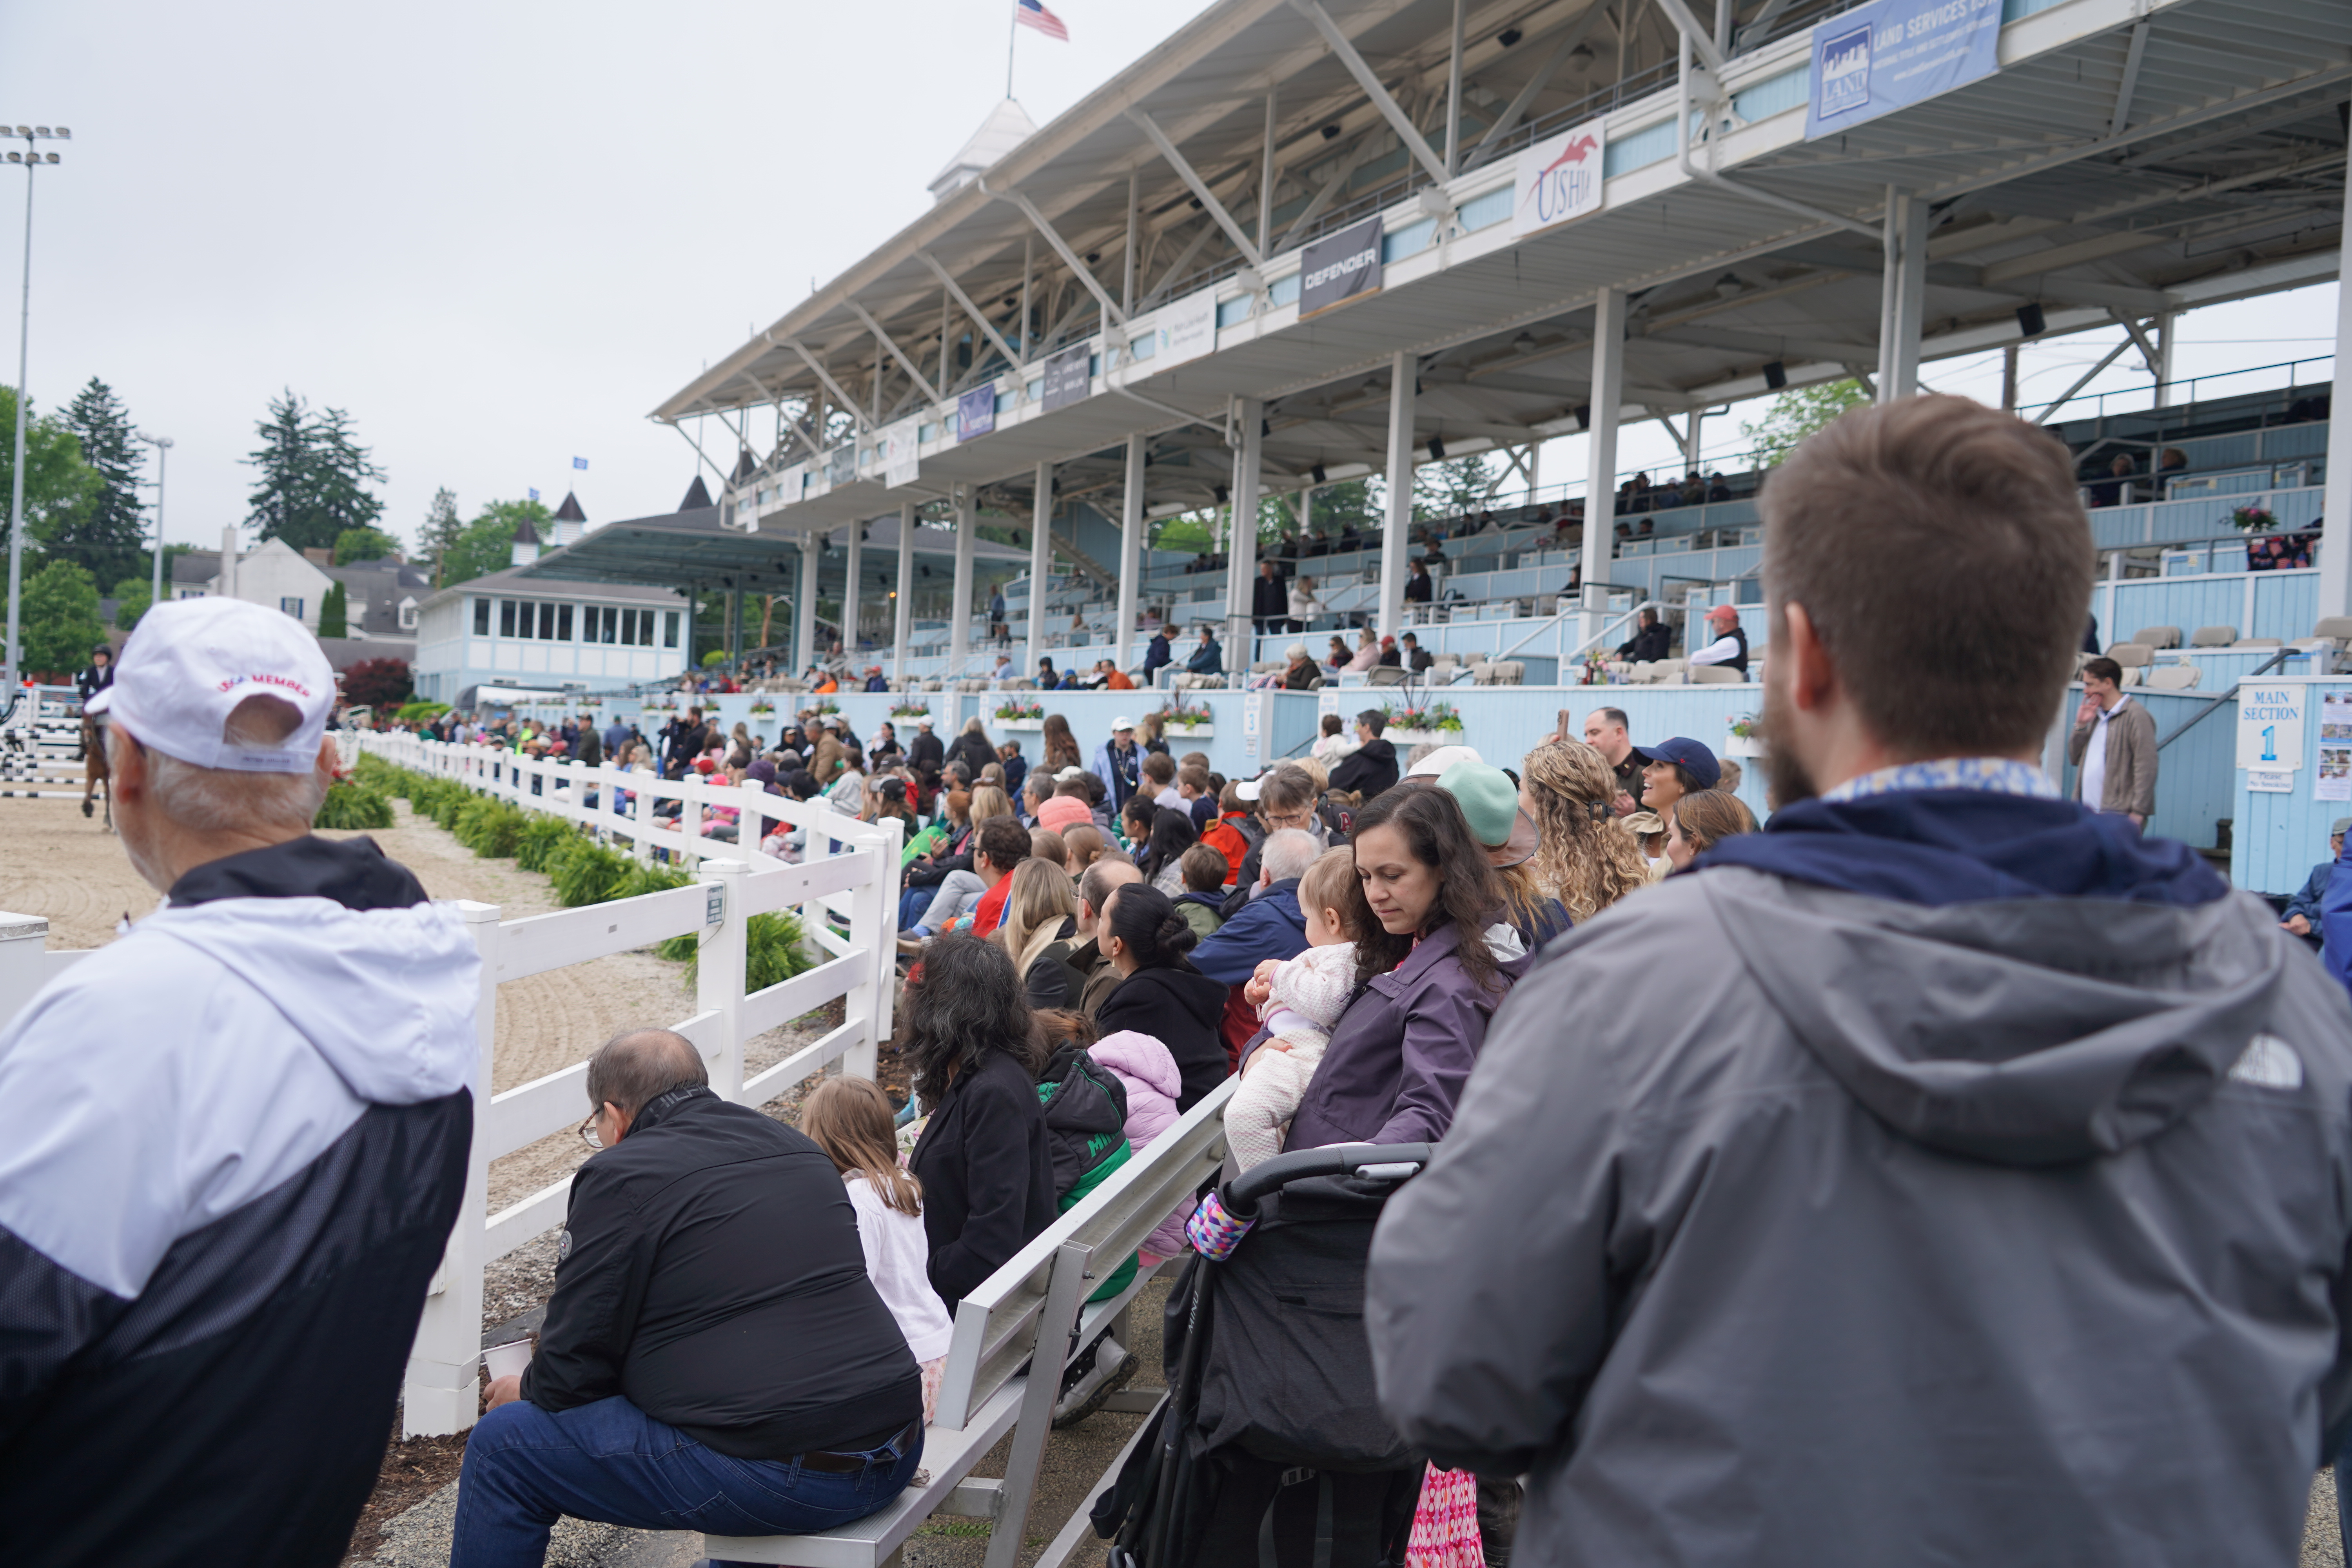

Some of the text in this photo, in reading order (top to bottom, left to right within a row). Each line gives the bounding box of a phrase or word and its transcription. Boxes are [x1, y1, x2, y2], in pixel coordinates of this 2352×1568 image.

[1874, 0, 1966, 52] LAND SERVICES
[1823, 70, 1867, 103] LAND
[1305, 248, 1376, 290] DEFENDER
[252, 675, 310, 697] MEMBER
[2254, 691, 2290, 704] MAIN
[1249, 713, 1254, 731] 3
[2243, 707, 2299, 720] SECTION
[2261, 725, 2277, 760] 1
[649, 1083, 706, 1118] HILFI
[1188, 1290, 1199, 1334] MINU
